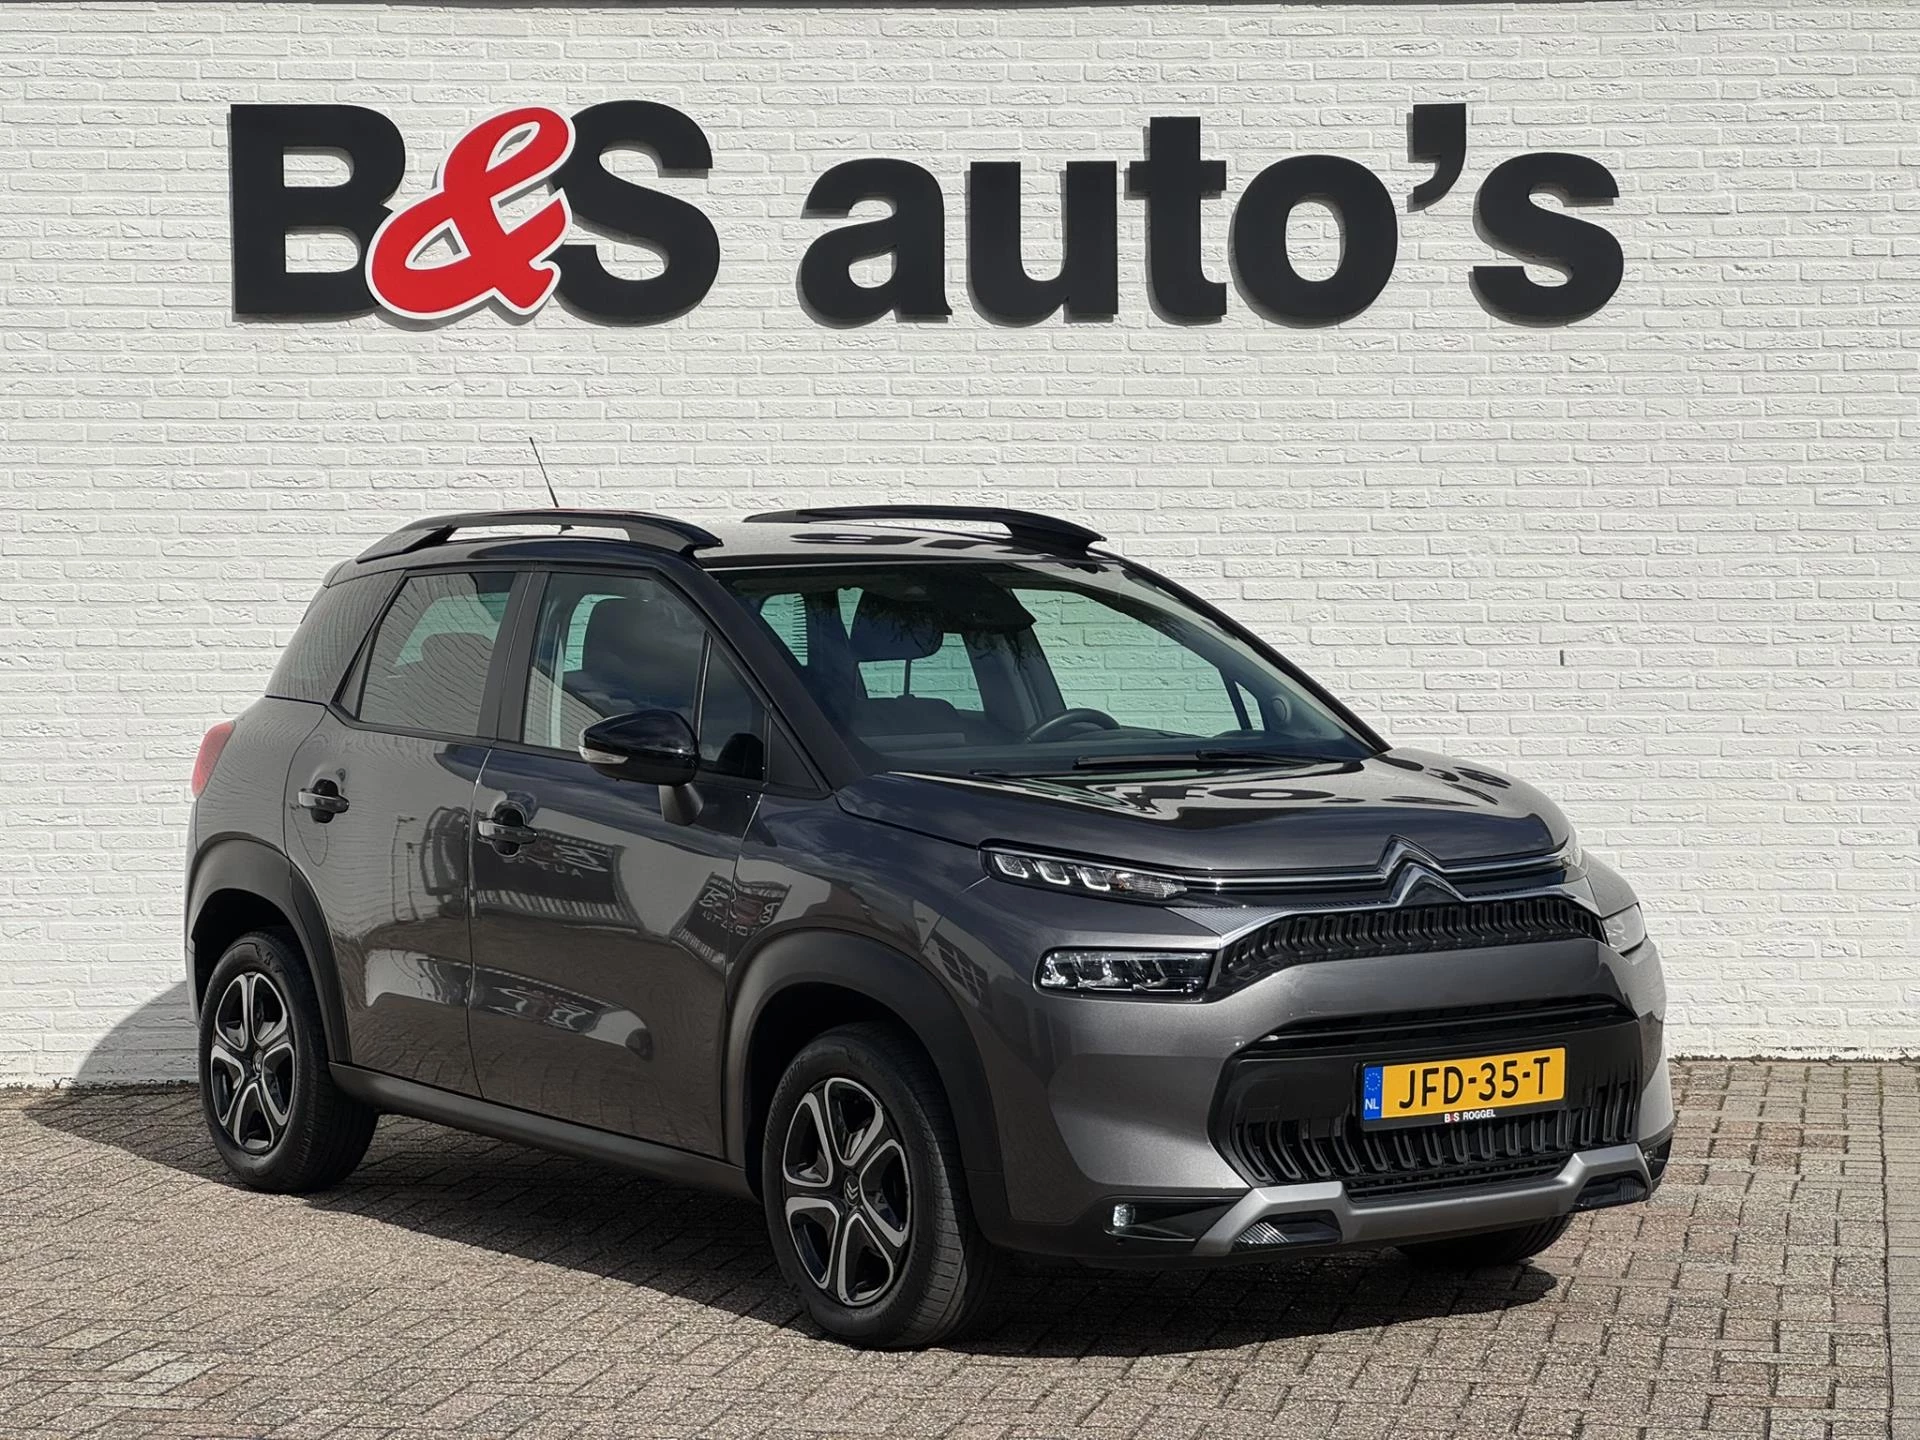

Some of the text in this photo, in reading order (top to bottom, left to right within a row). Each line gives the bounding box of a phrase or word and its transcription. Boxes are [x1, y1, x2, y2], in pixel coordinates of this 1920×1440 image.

[231, 100, 1624, 324] B&S auto's
[1399, 1057, 1550, 1109] JFD-35-T
[1364, 1097, 1380, 1111] NL
[1462, 1108, 1496, 1121] ROGGEL
